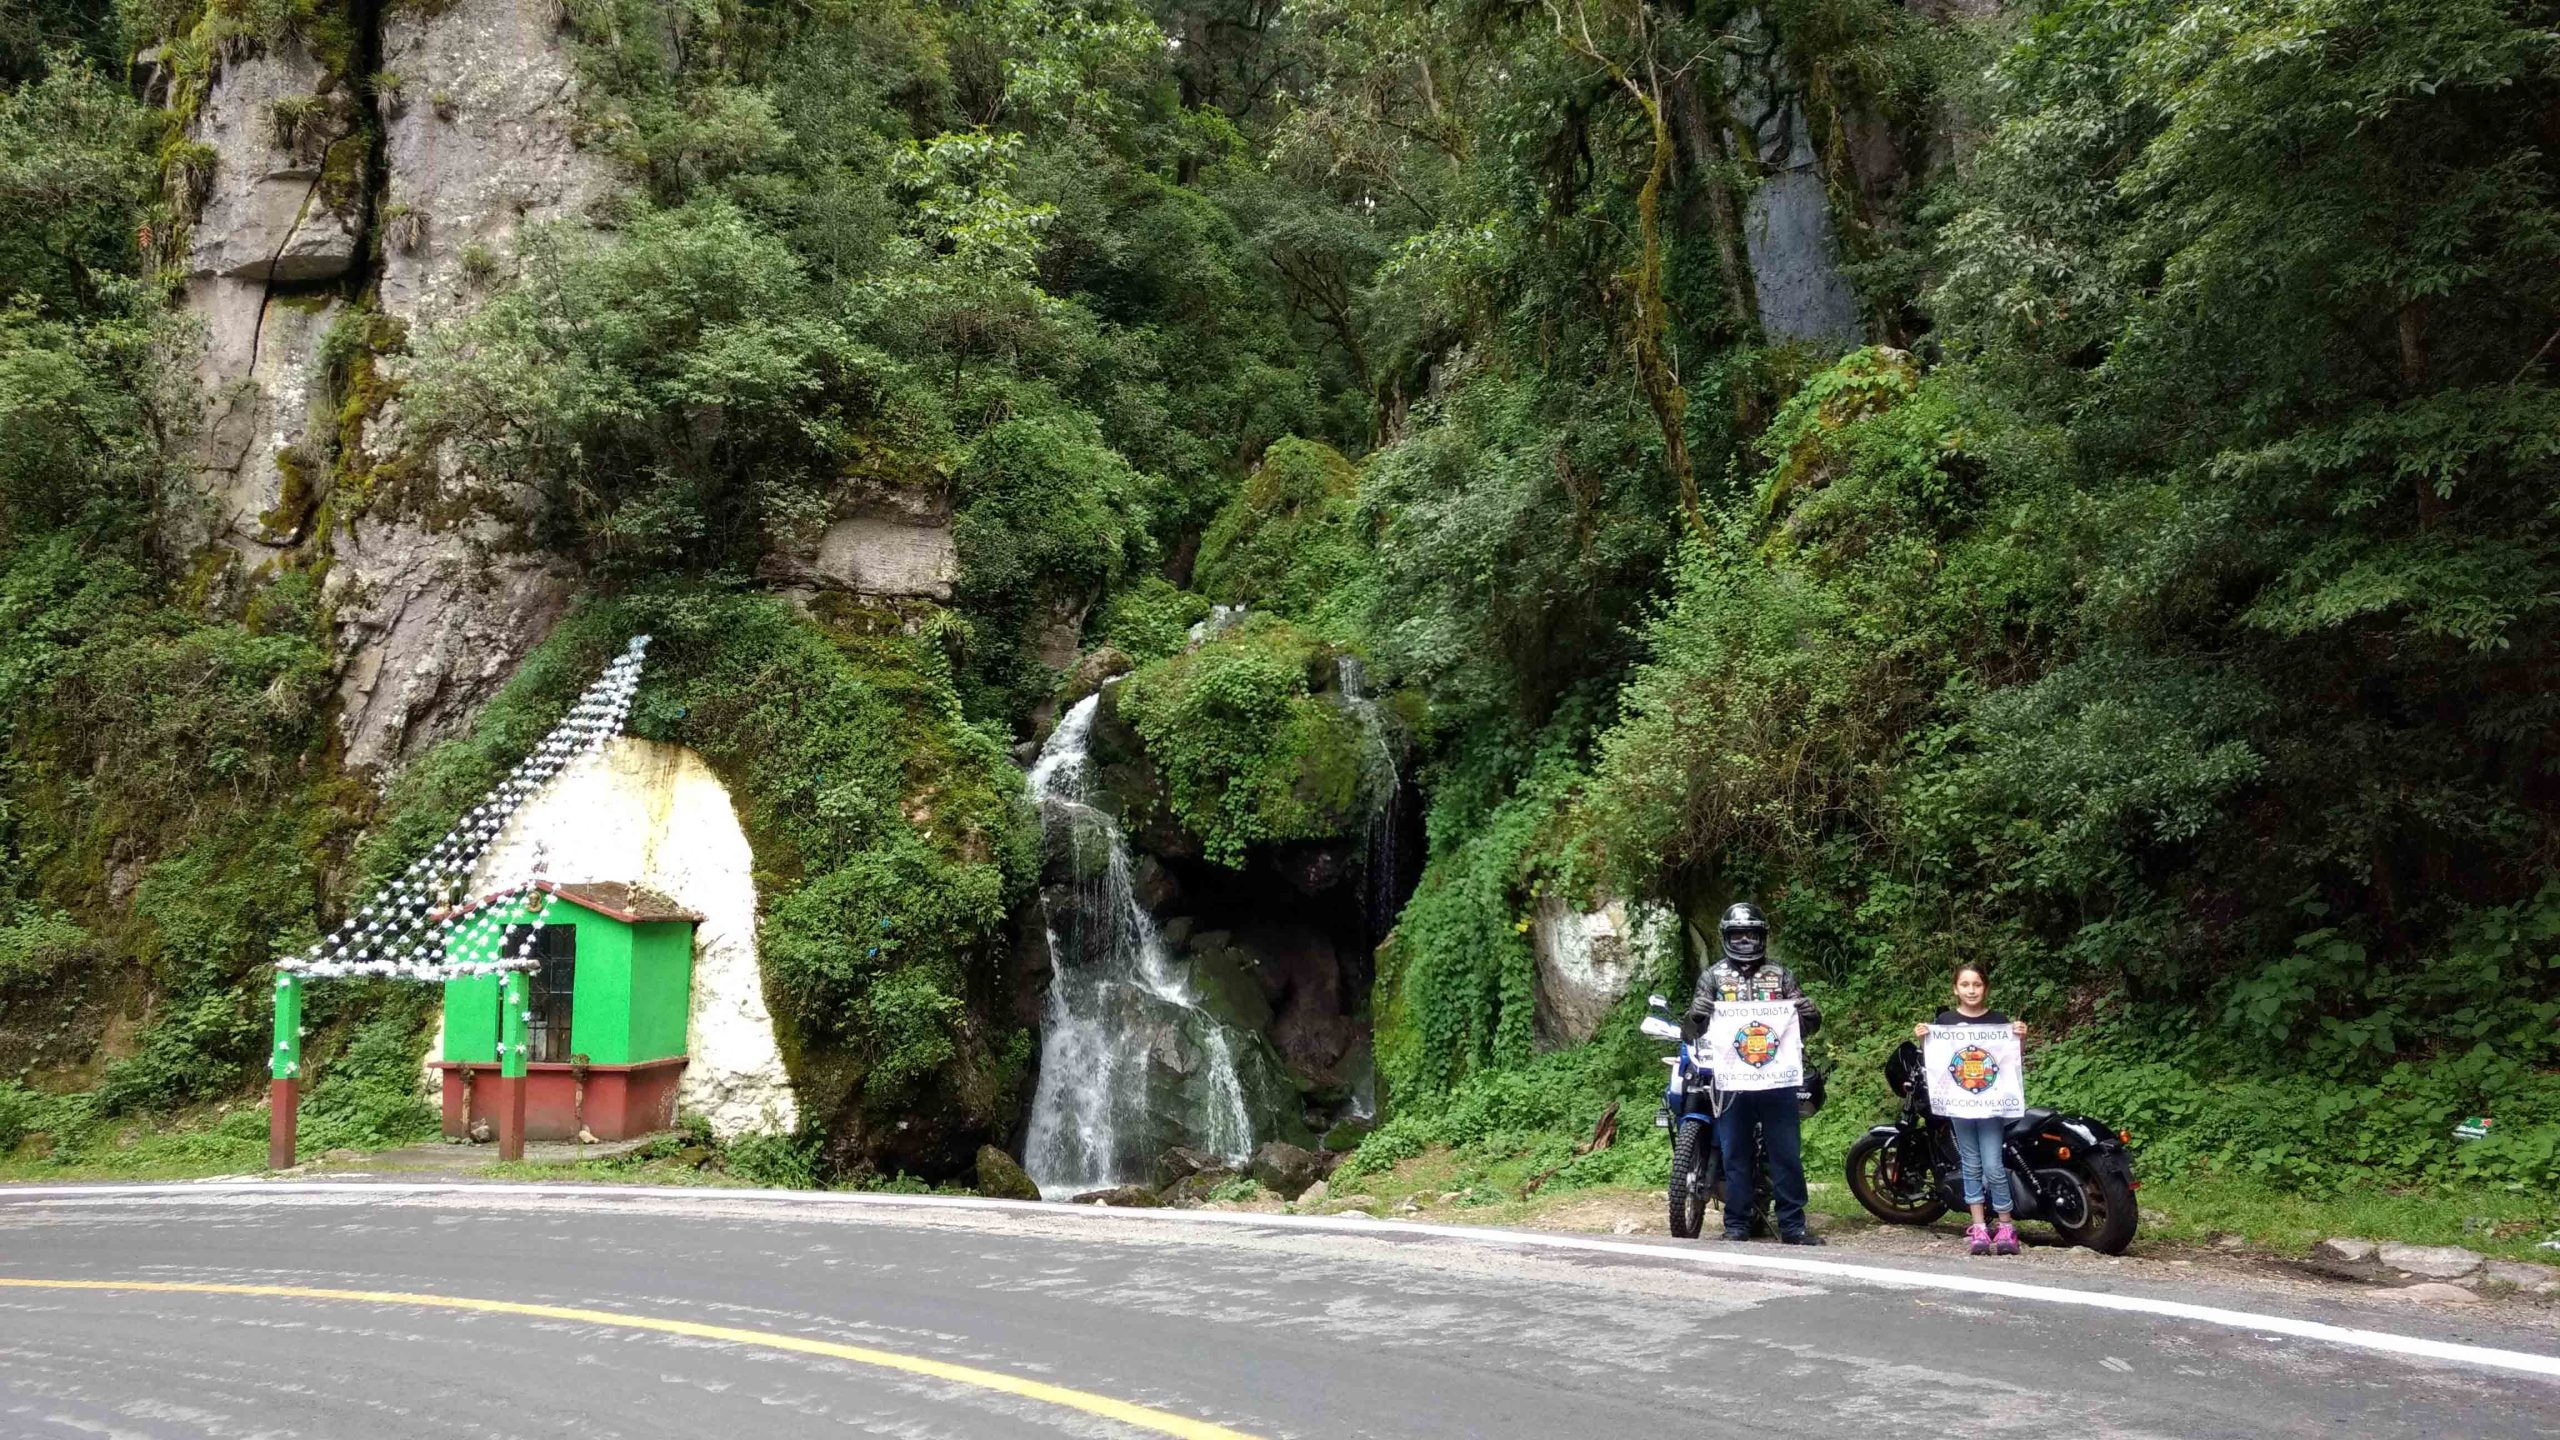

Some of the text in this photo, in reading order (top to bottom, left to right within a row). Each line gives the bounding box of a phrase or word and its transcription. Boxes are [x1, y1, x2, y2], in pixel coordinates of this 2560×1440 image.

[1718, 1006, 1789, 1017] MOTO TURISTA
[1933, 1030, 2009, 1040] MOTO TURISTA
[1718, 1072, 1728, 1081] EN
[1932, 1098, 1944, 1106] EN
